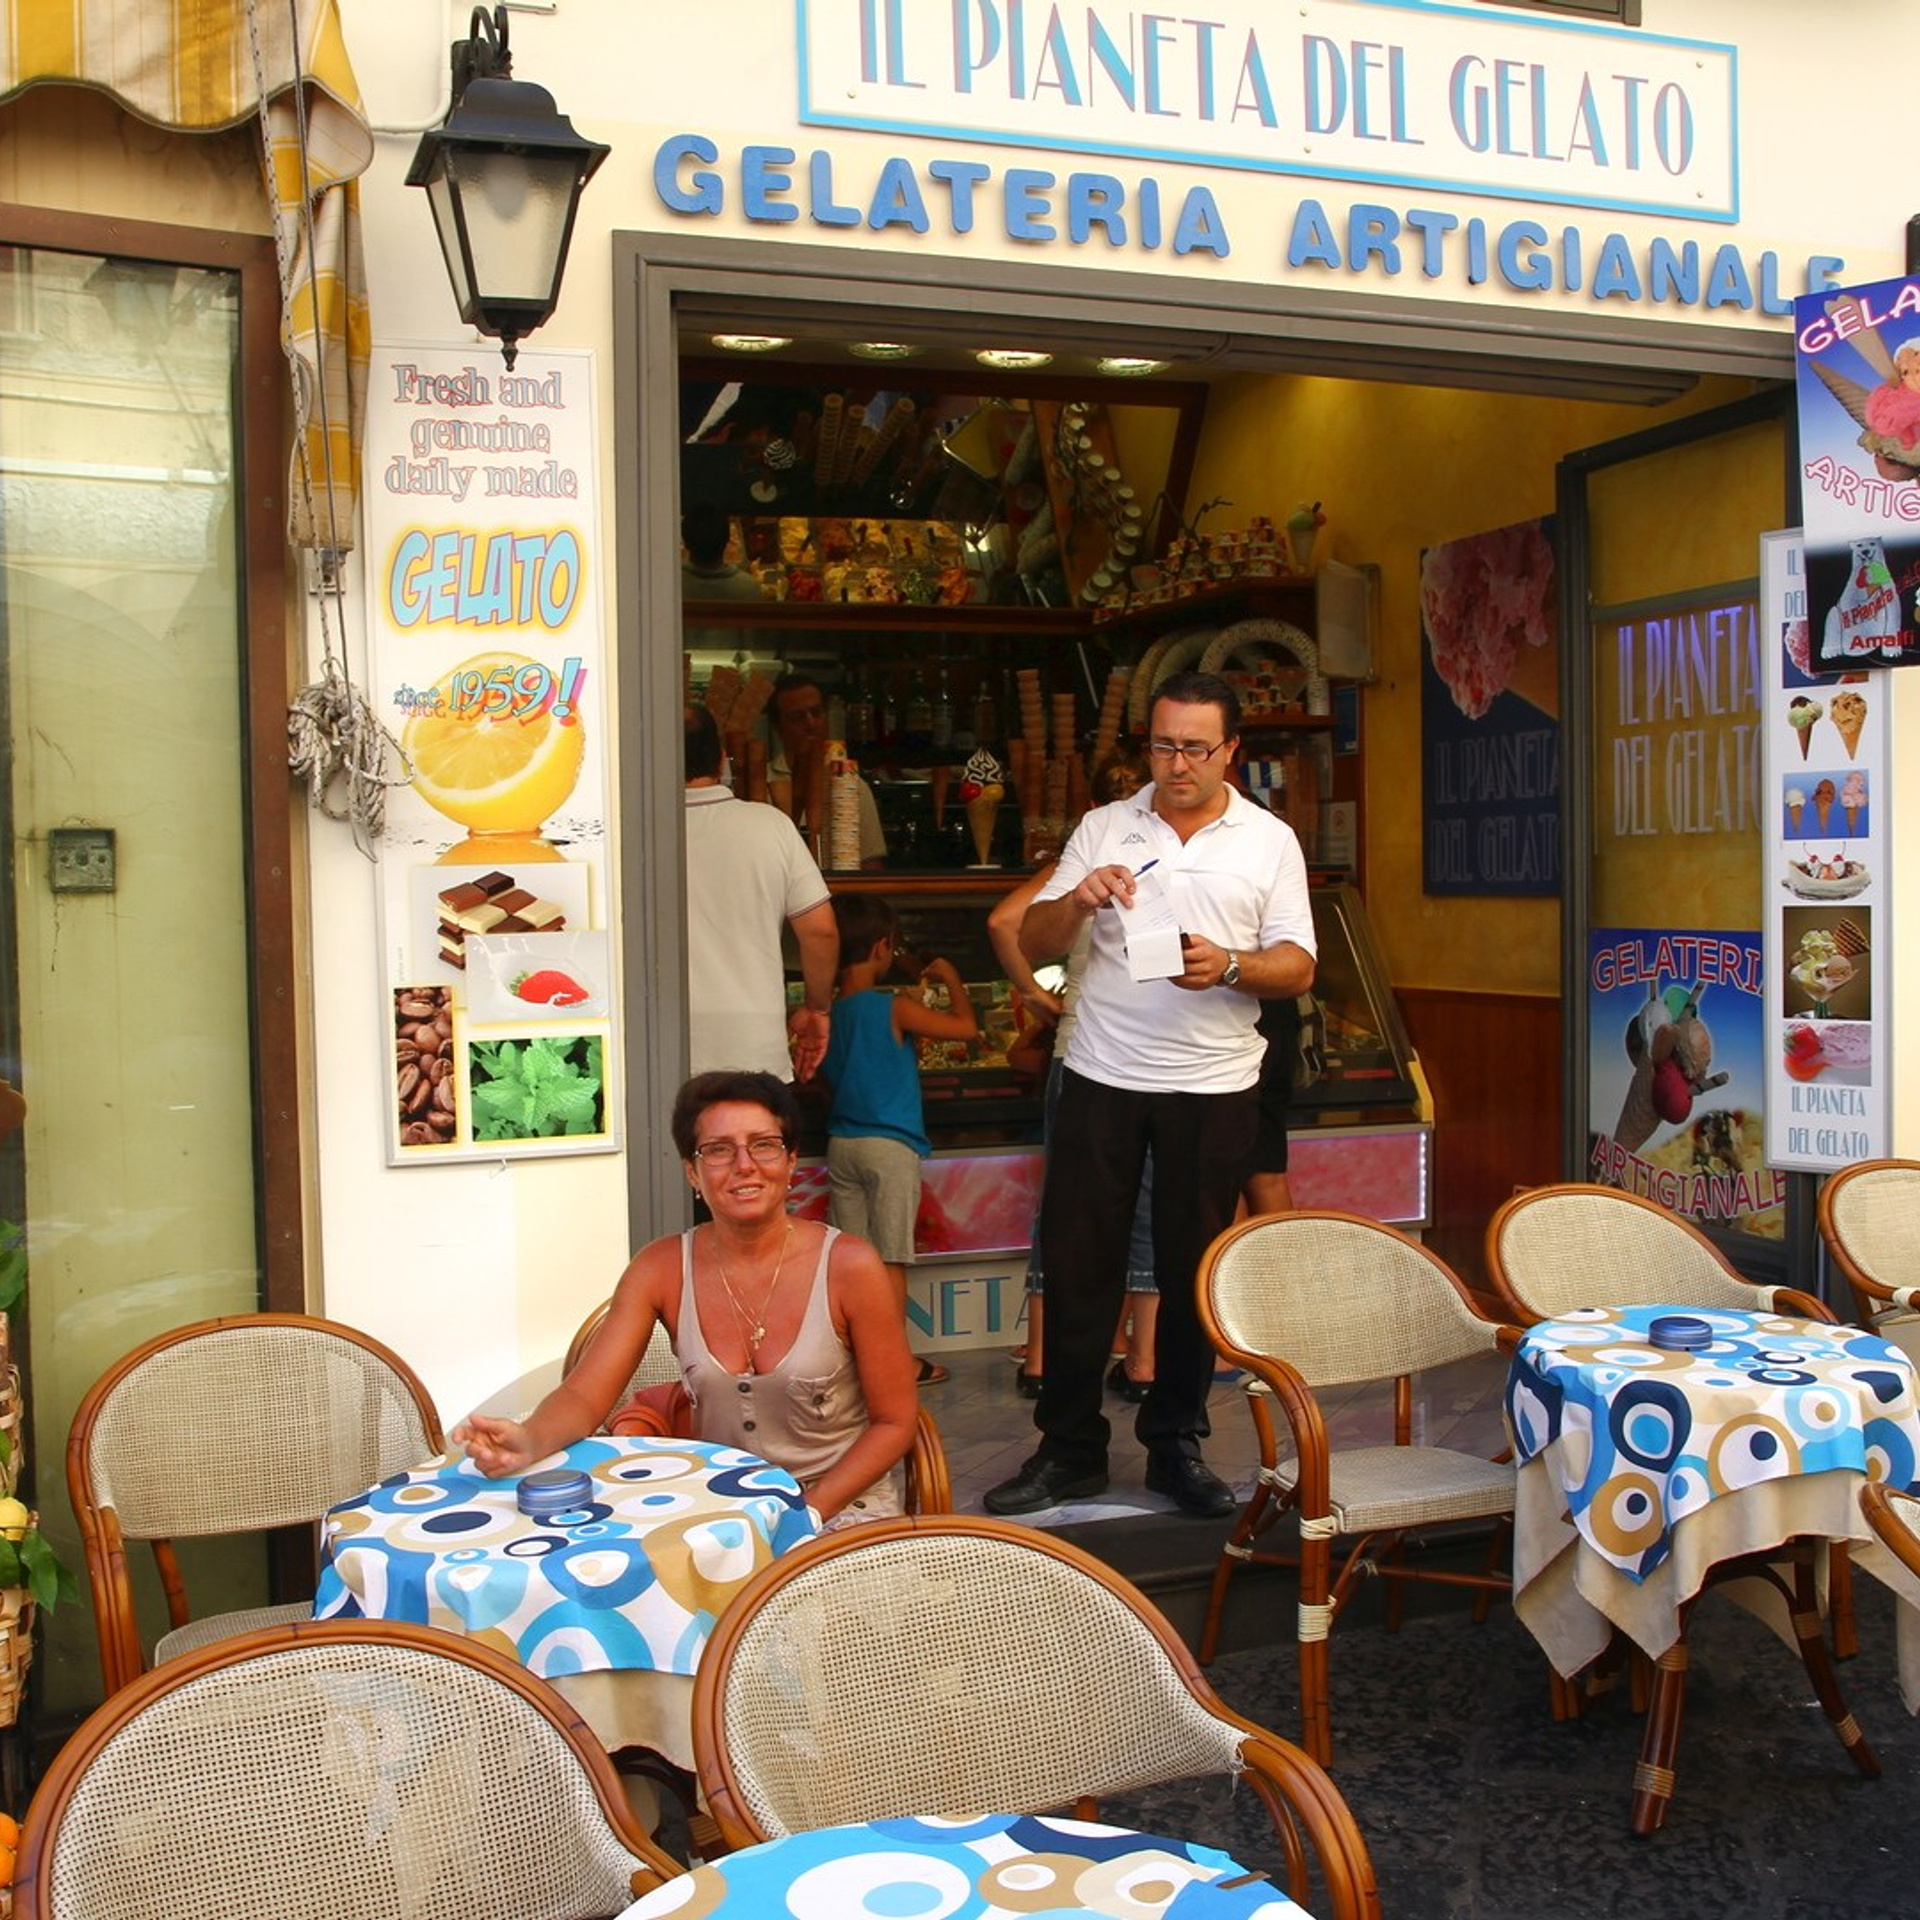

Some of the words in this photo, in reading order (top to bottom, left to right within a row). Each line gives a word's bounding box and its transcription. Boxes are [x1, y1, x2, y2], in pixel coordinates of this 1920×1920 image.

[859, 0, 927, 89] IL
[951, 0, 1280, 130] PIANETA
[1302, 33, 1426, 146] DEL
[1448, 54, 1695, 177] GELATO
[652, 132, 1231, 259] GELATERIA
[391, 364, 493, 408] Fresh
[499, 371, 566, 409] and
[410, 414, 551, 459] genuine
[384, 455, 478, 503] daily
[483, 460, 579, 500] made
[389, 529, 581, 628] GELATO
[1786, 549, 1801, 576] IL
[1618, 625, 1641, 726] IL
[1646, 603, 1761, 723] PIANETA
[1850, 630, 1915, 651] Amalfi
[392, 682, 445, 716] since
[448, 656, 586, 722] 1959!
[1435, 740, 1457, 805] IL
[1614, 734, 1659, 837] DEL
[1430, 818, 1474, 883] DEL
[1477, 812, 1560, 883] GELAT
[1591, 935, 1763, 998] GELATERI
[1791, 1085, 1803, 1113] IL
[1807, 1086, 1866, 1117] PIANETA
[1788, 1126, 1813, 1155] DEL
[1816, 1128, 1870, 1159] GELATO
[1591, 1133, 1786, 1220] ARTIGIANALE
